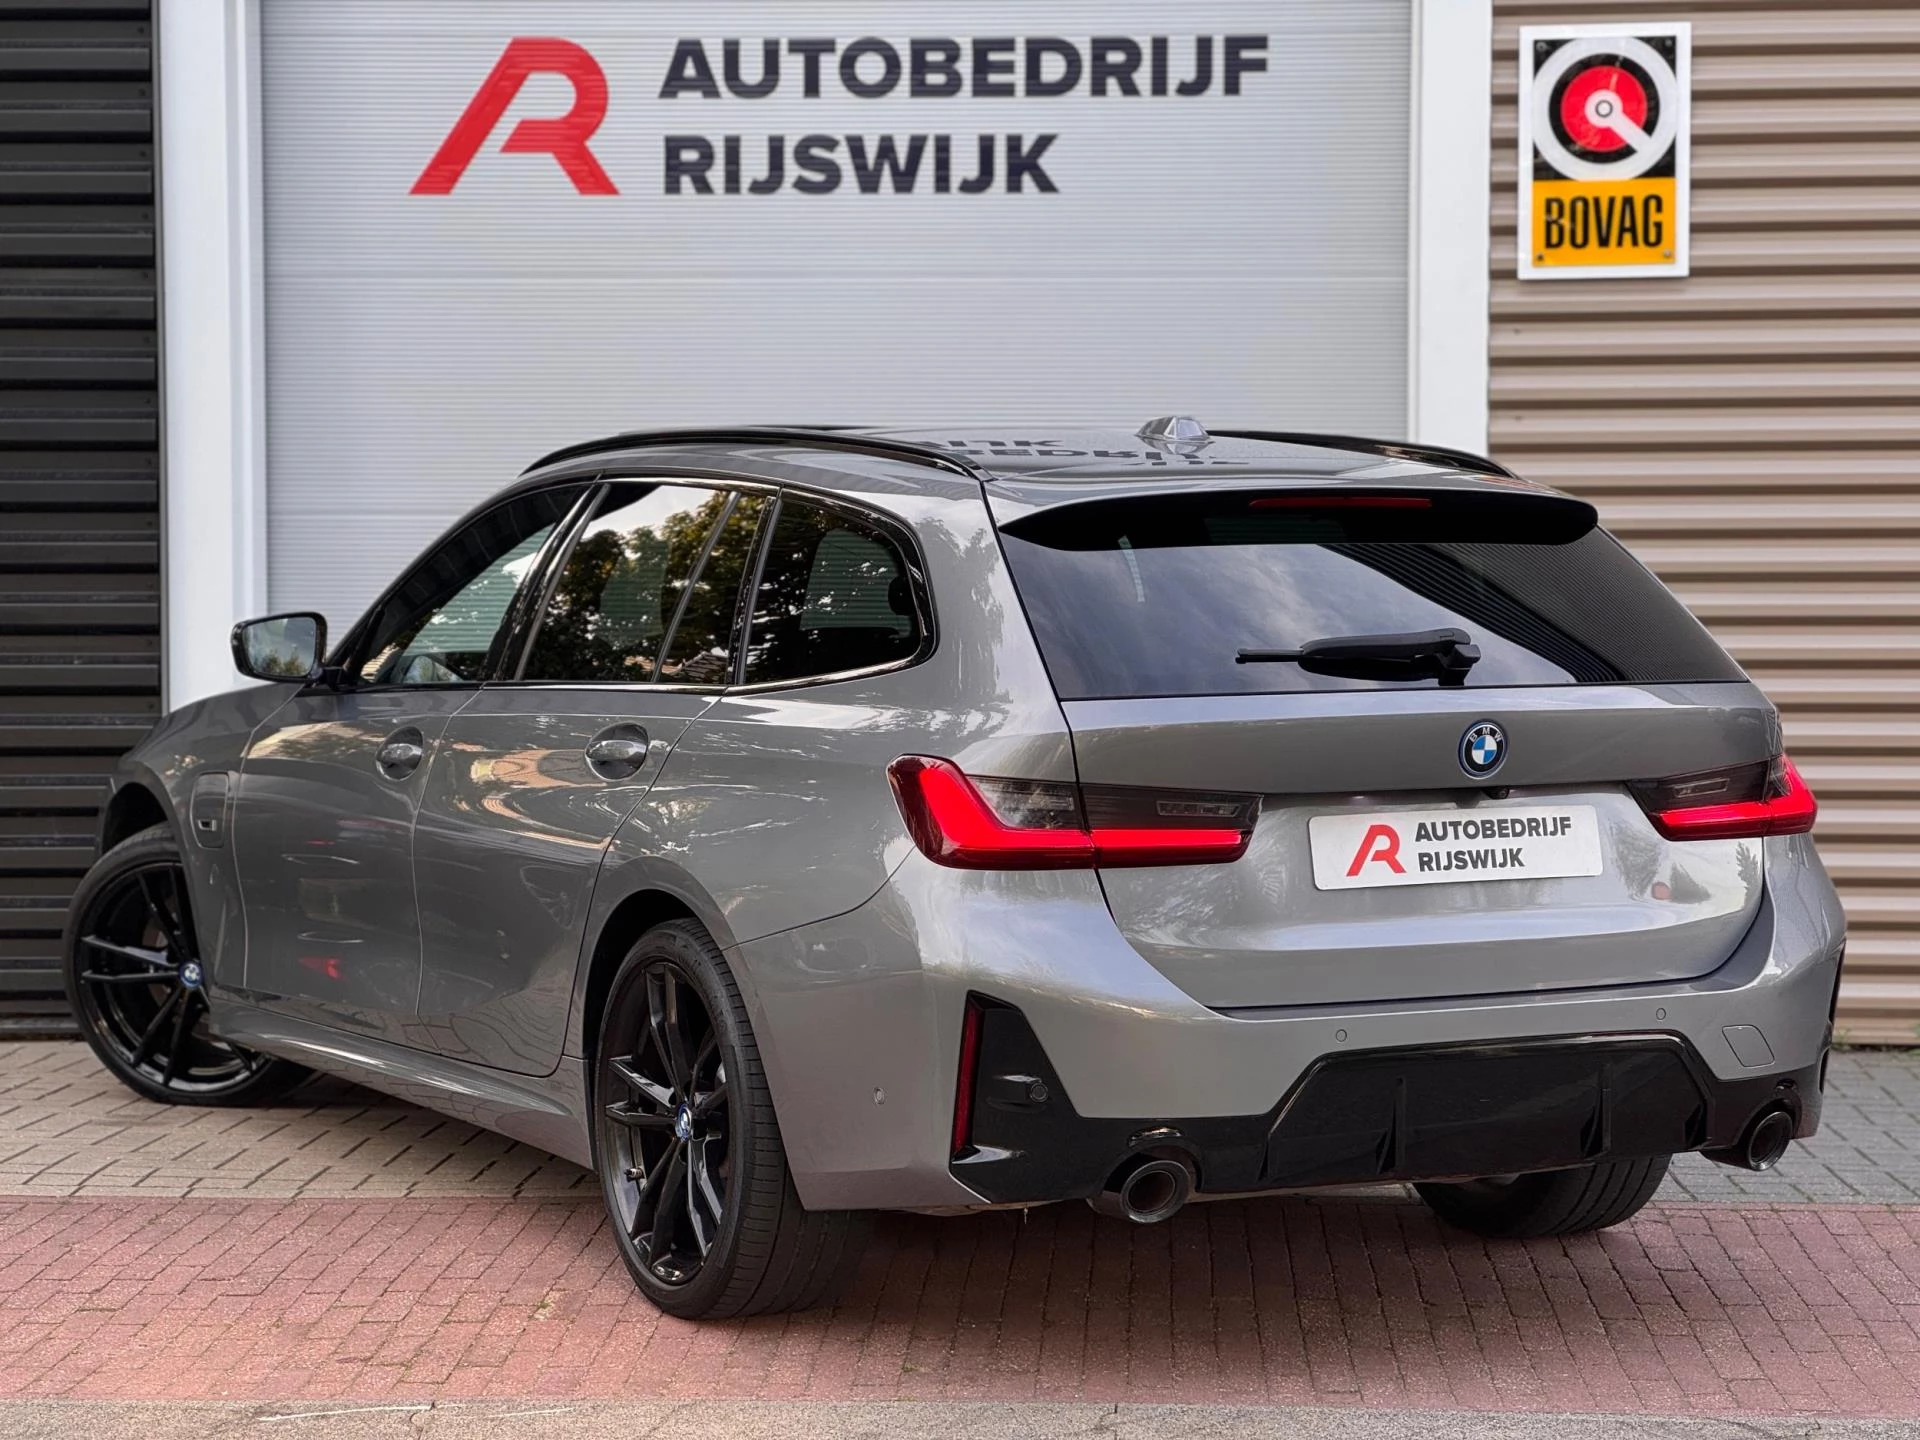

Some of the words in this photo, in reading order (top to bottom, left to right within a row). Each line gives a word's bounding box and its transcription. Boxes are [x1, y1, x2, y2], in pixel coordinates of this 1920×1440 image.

[658, 34, 1270, 99] AUTOBEDRIJF
[664, 133, 1060, 195] RIJSWIJK
[1544, 194, 1663, 250] BOVAG
[1469, 726, 1503, 743] BMW
[1415, 816, 1572, 842] AUTOBEDRIJF
[1418, 847, 1525, 872] RIJSWIJK
